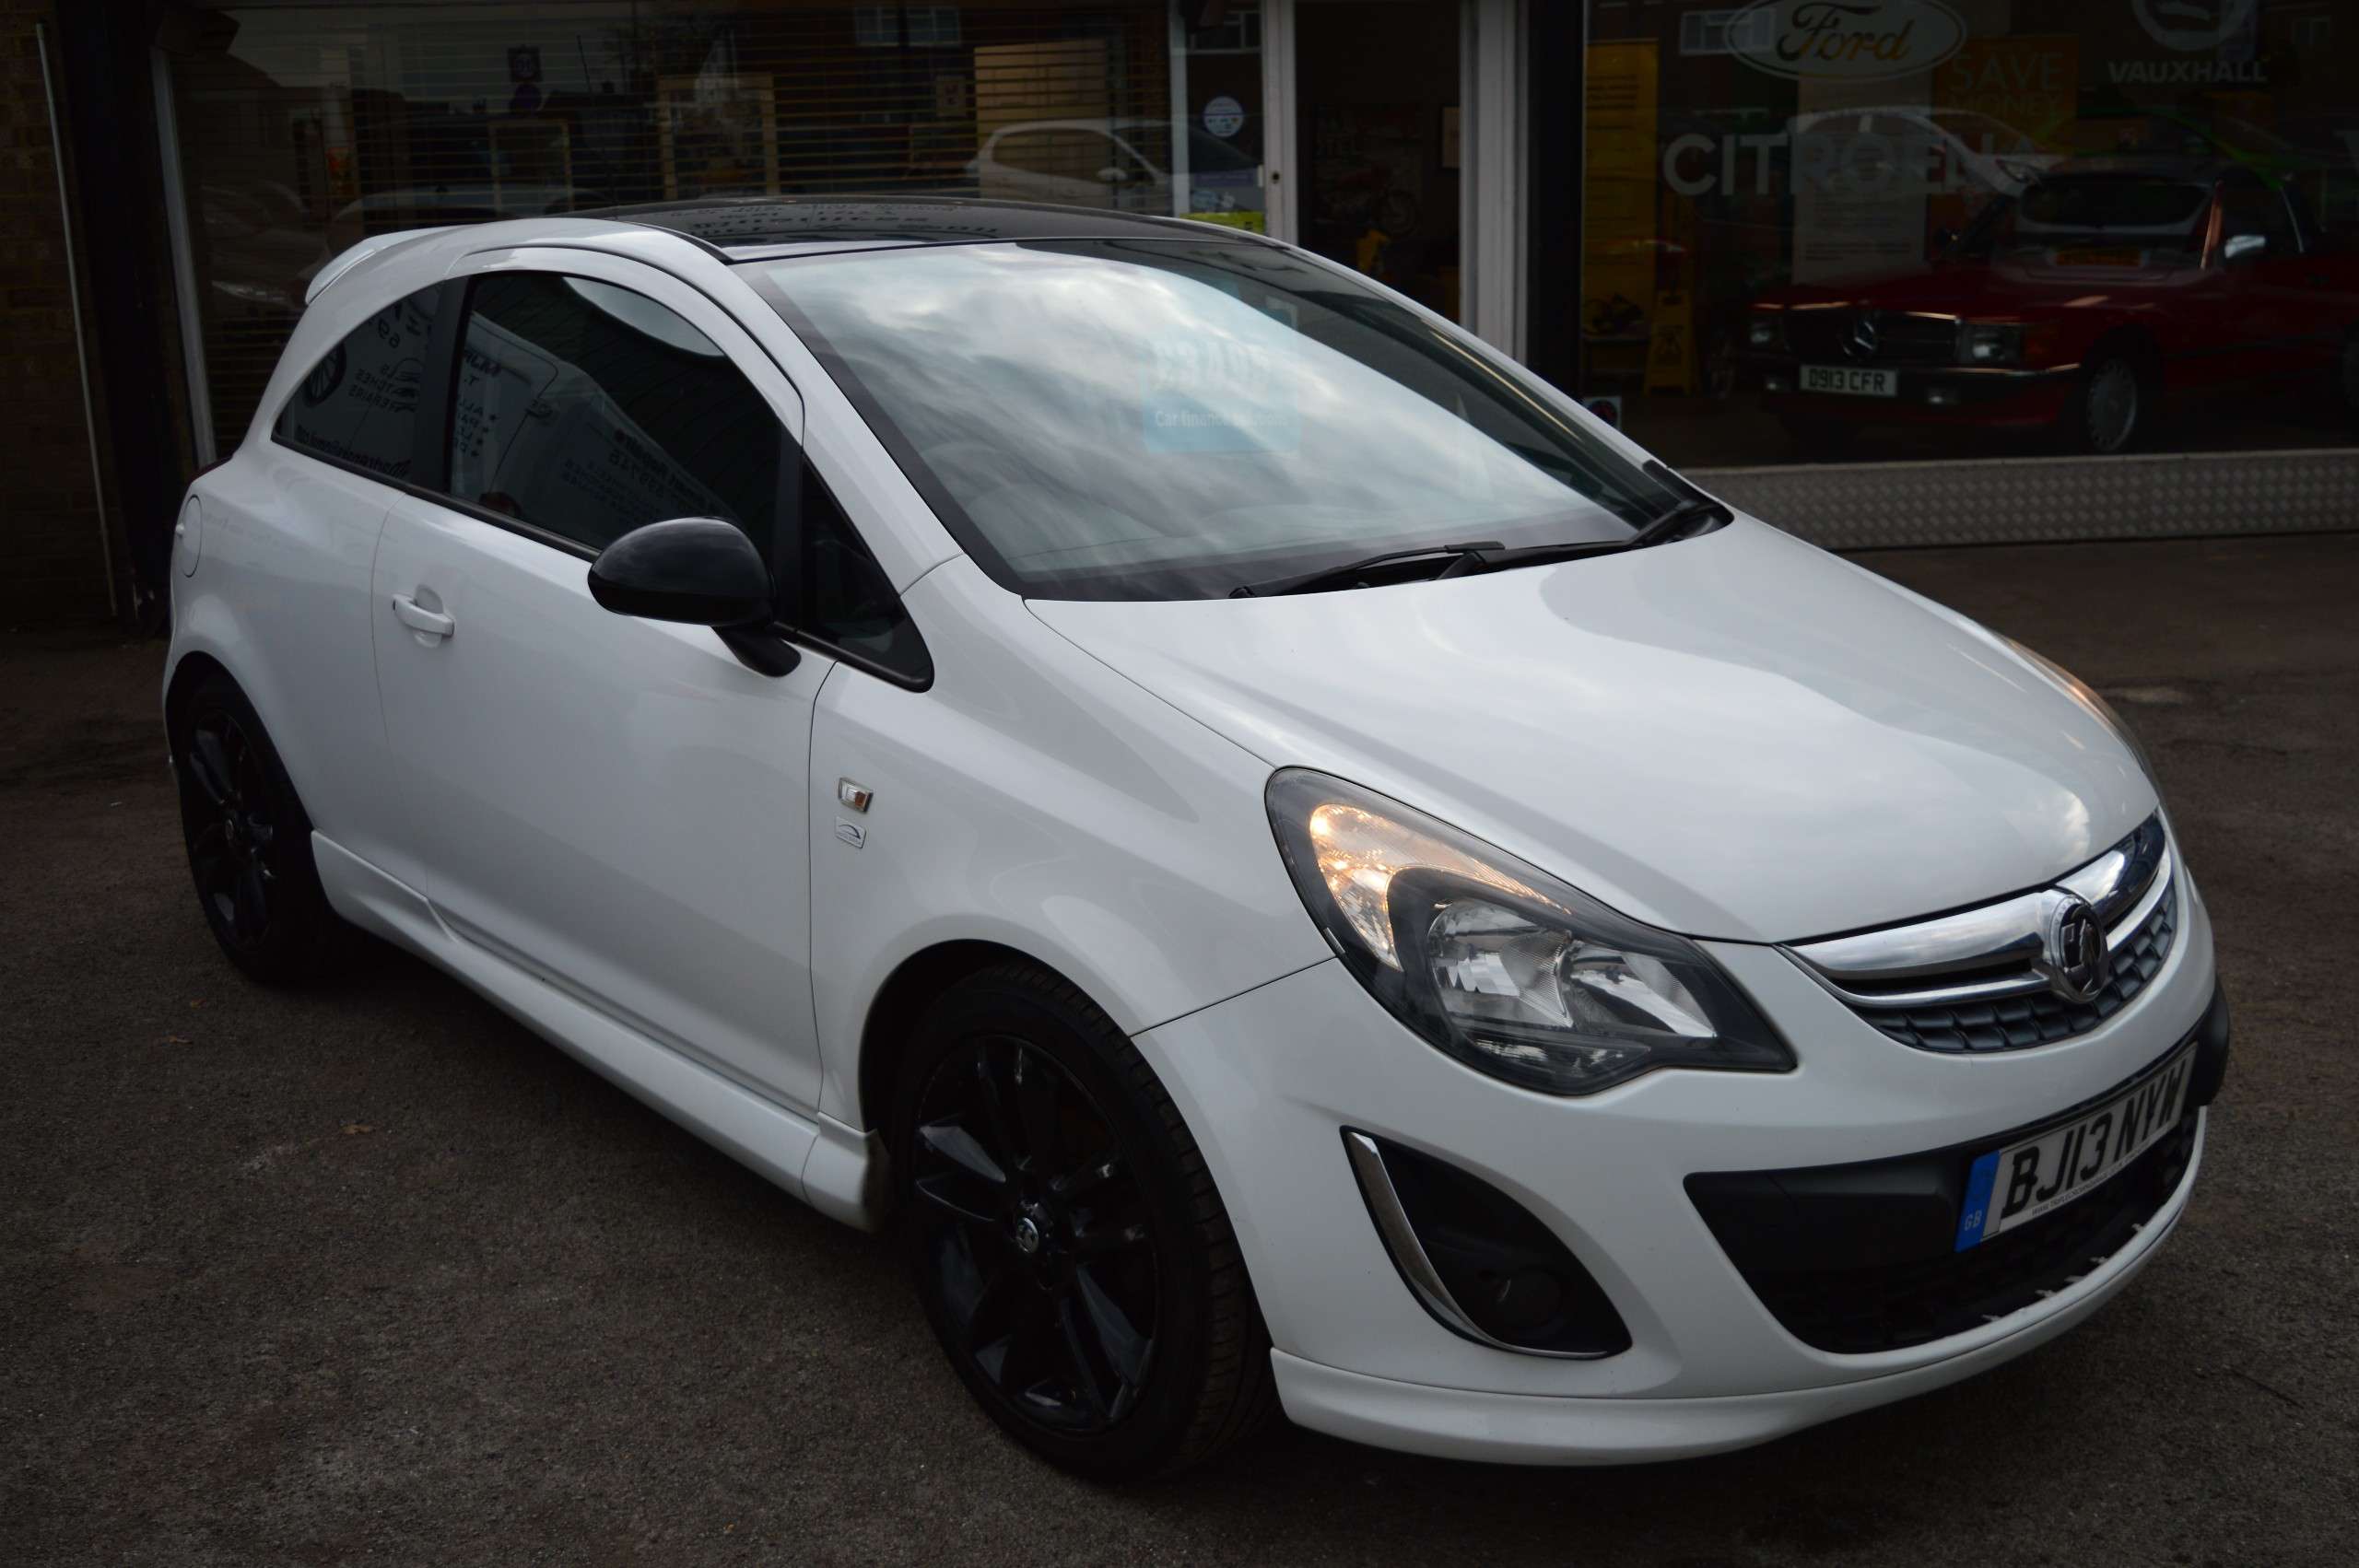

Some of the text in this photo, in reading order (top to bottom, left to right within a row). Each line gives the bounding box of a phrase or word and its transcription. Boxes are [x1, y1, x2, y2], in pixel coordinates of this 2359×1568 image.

[1776, 2, 1915, 62] Ford
[1948, 51, 2066, 90] SAVE
[2107, 59, 2269, 84] VAUXHALL
[1849, 370, 1884, 392] CFR
[2001, 1059, 2187, 1219] BJ13 NYW
[1964, 1209, 1982, 1231] GB
